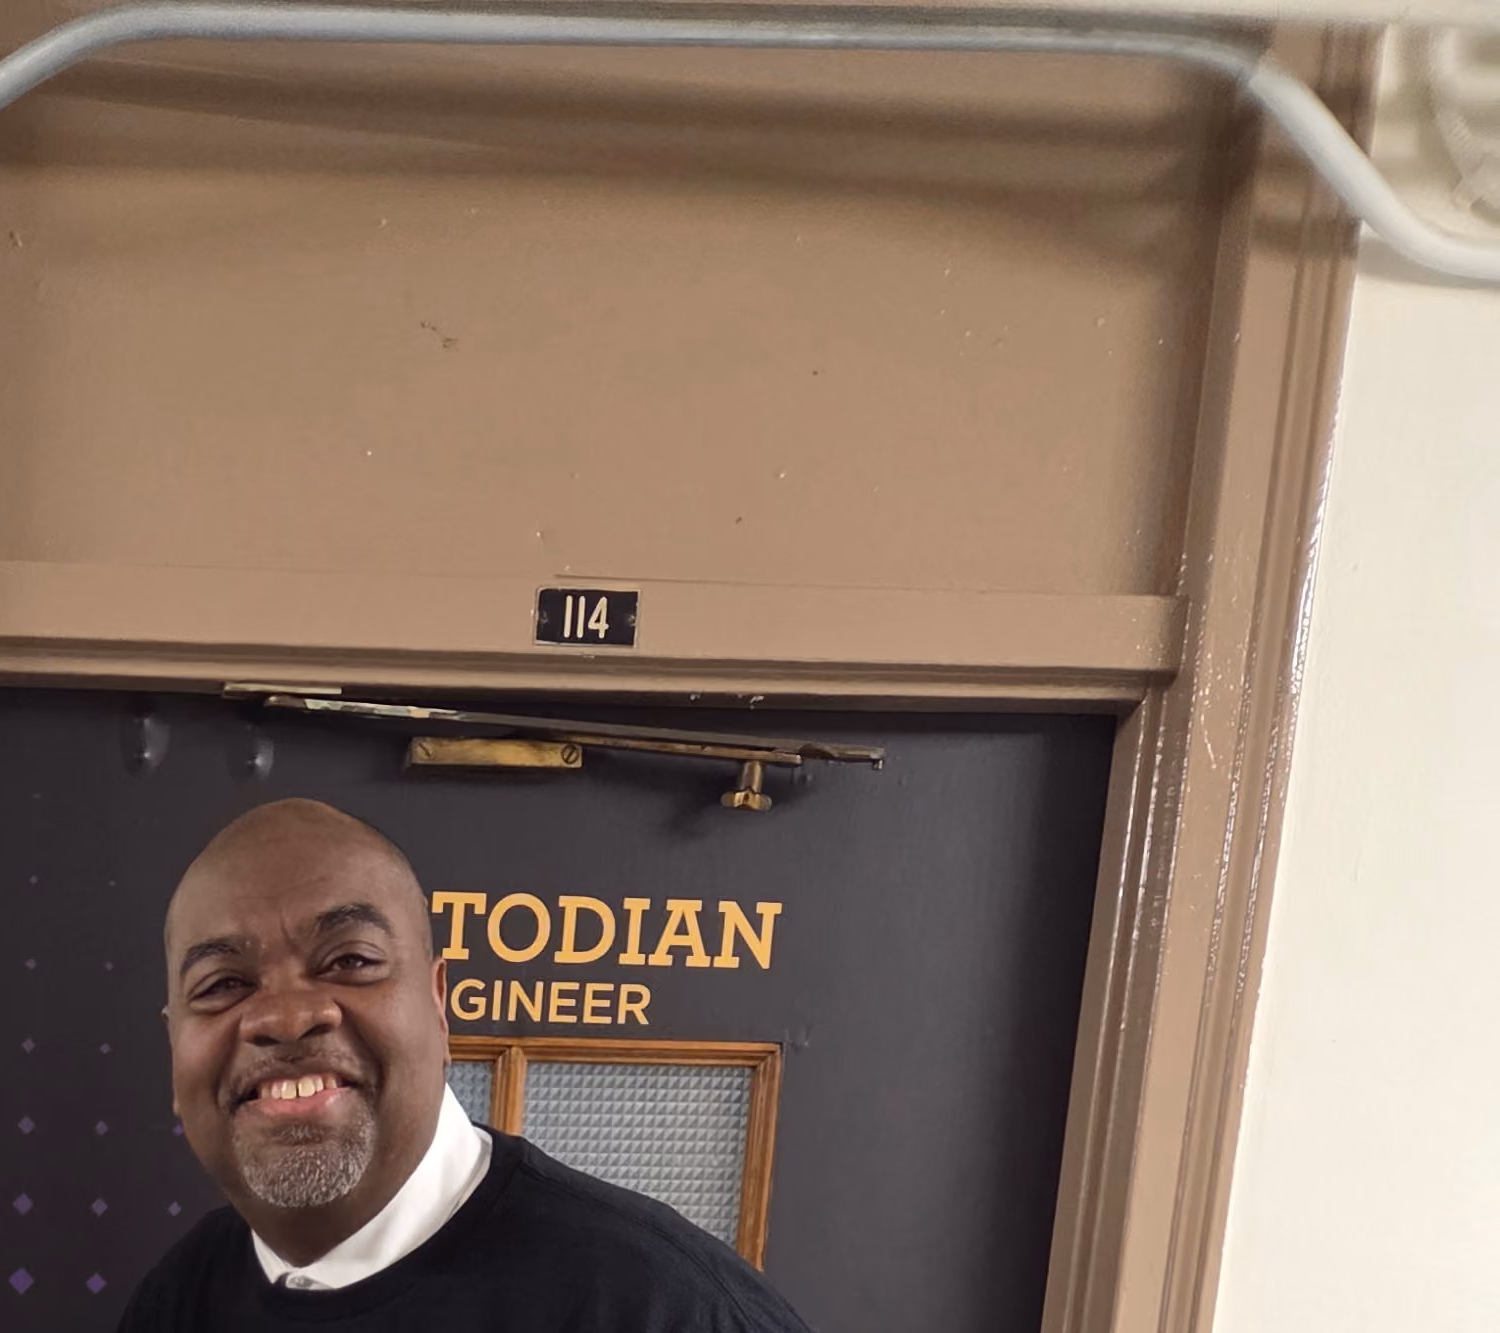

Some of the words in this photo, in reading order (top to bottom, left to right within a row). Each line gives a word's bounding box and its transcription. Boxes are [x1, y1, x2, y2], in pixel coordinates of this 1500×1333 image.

[563, 594, 609, 640] 114
[431, 891, 783, 970] TODIAN
[451, 978, 651, 1026] GINEER
